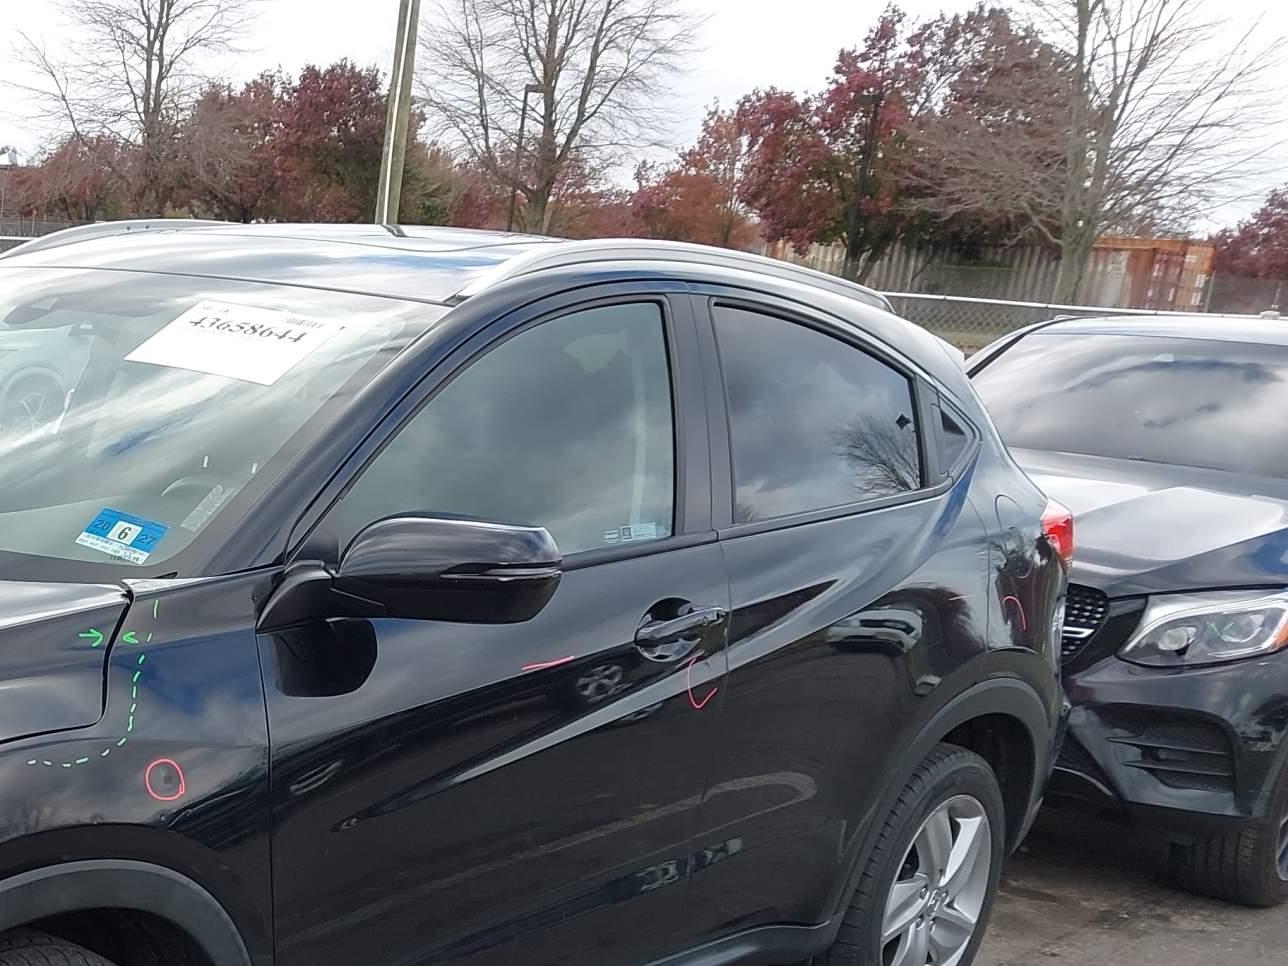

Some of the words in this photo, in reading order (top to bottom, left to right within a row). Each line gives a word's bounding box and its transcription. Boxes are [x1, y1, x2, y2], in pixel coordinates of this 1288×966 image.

[189, 316, 307, 343] 43658644
[94, 519, 111, 531] 20
[117, 526, 132, 541] 6
[136, 534, 157, 546] 27
